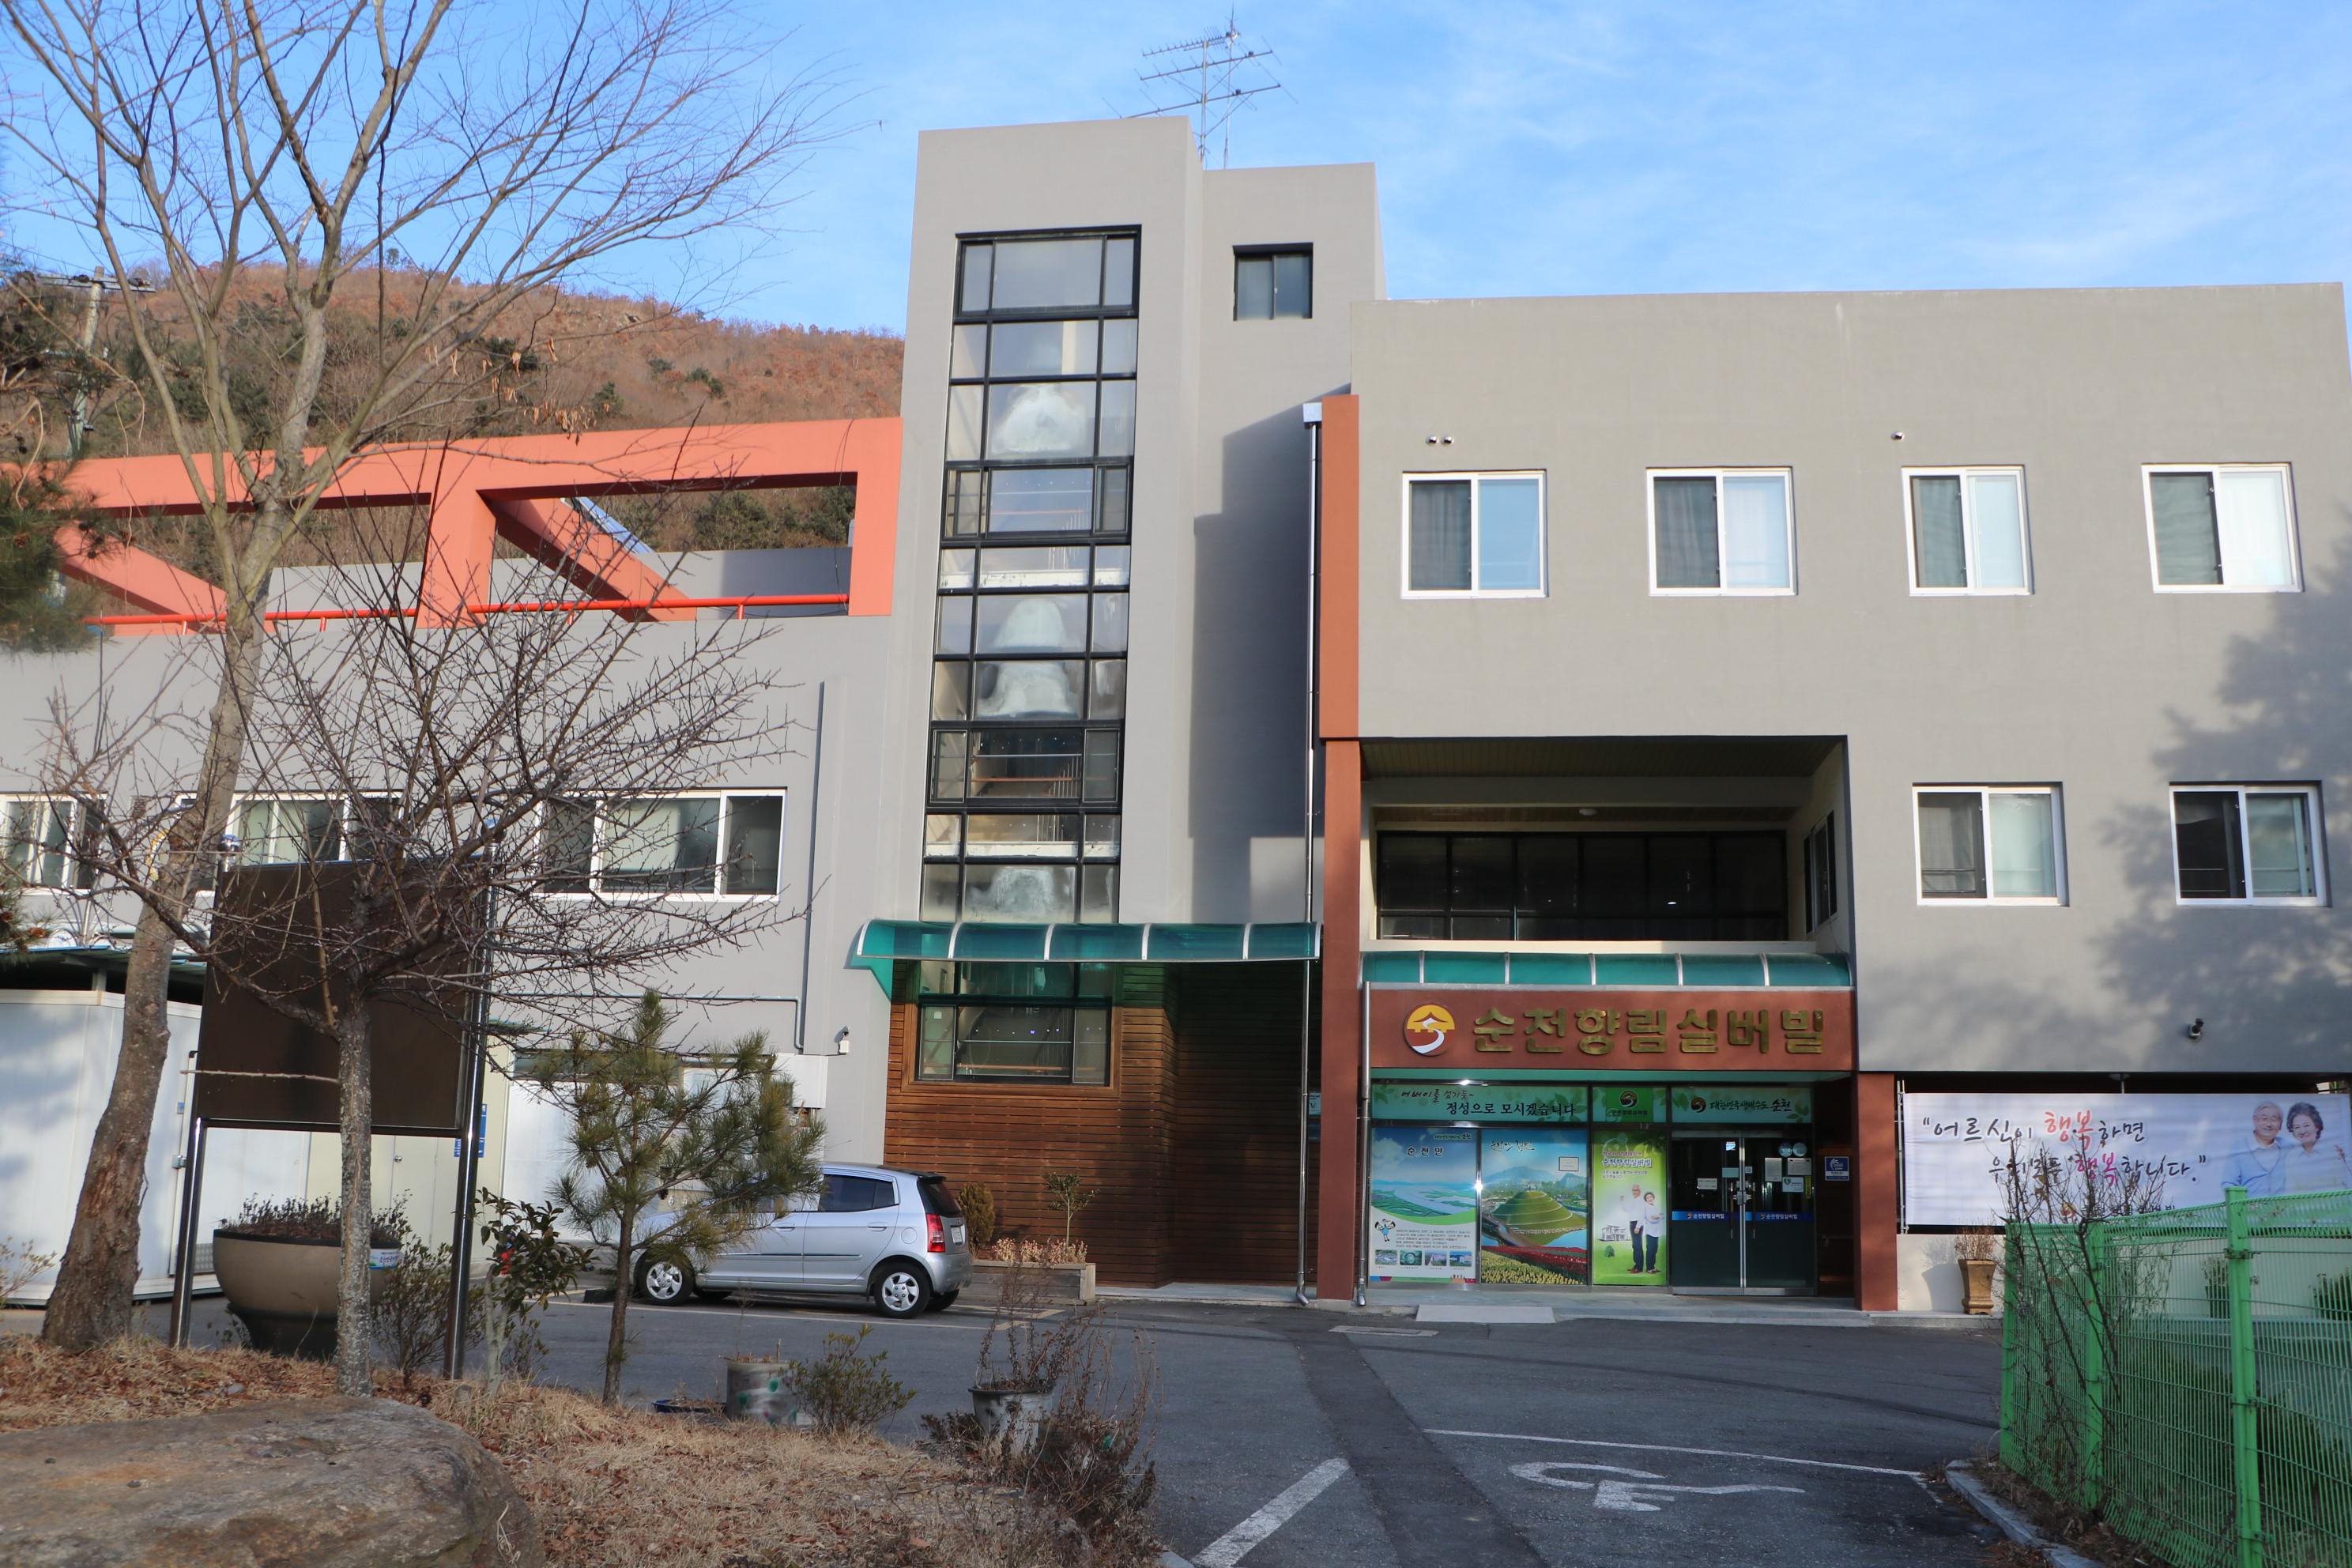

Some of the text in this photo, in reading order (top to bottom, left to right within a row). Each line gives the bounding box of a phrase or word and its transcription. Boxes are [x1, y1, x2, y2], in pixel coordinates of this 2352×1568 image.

[1473, 1007, 1824, 1056] 순천향림실버빌
[1446, 1102, 1576, 1117] 정성으로 모시겠습니다
[1770, 1098, 1792, 1112] 순천
[2045, 1109, 2145, 1151] 행복하면
